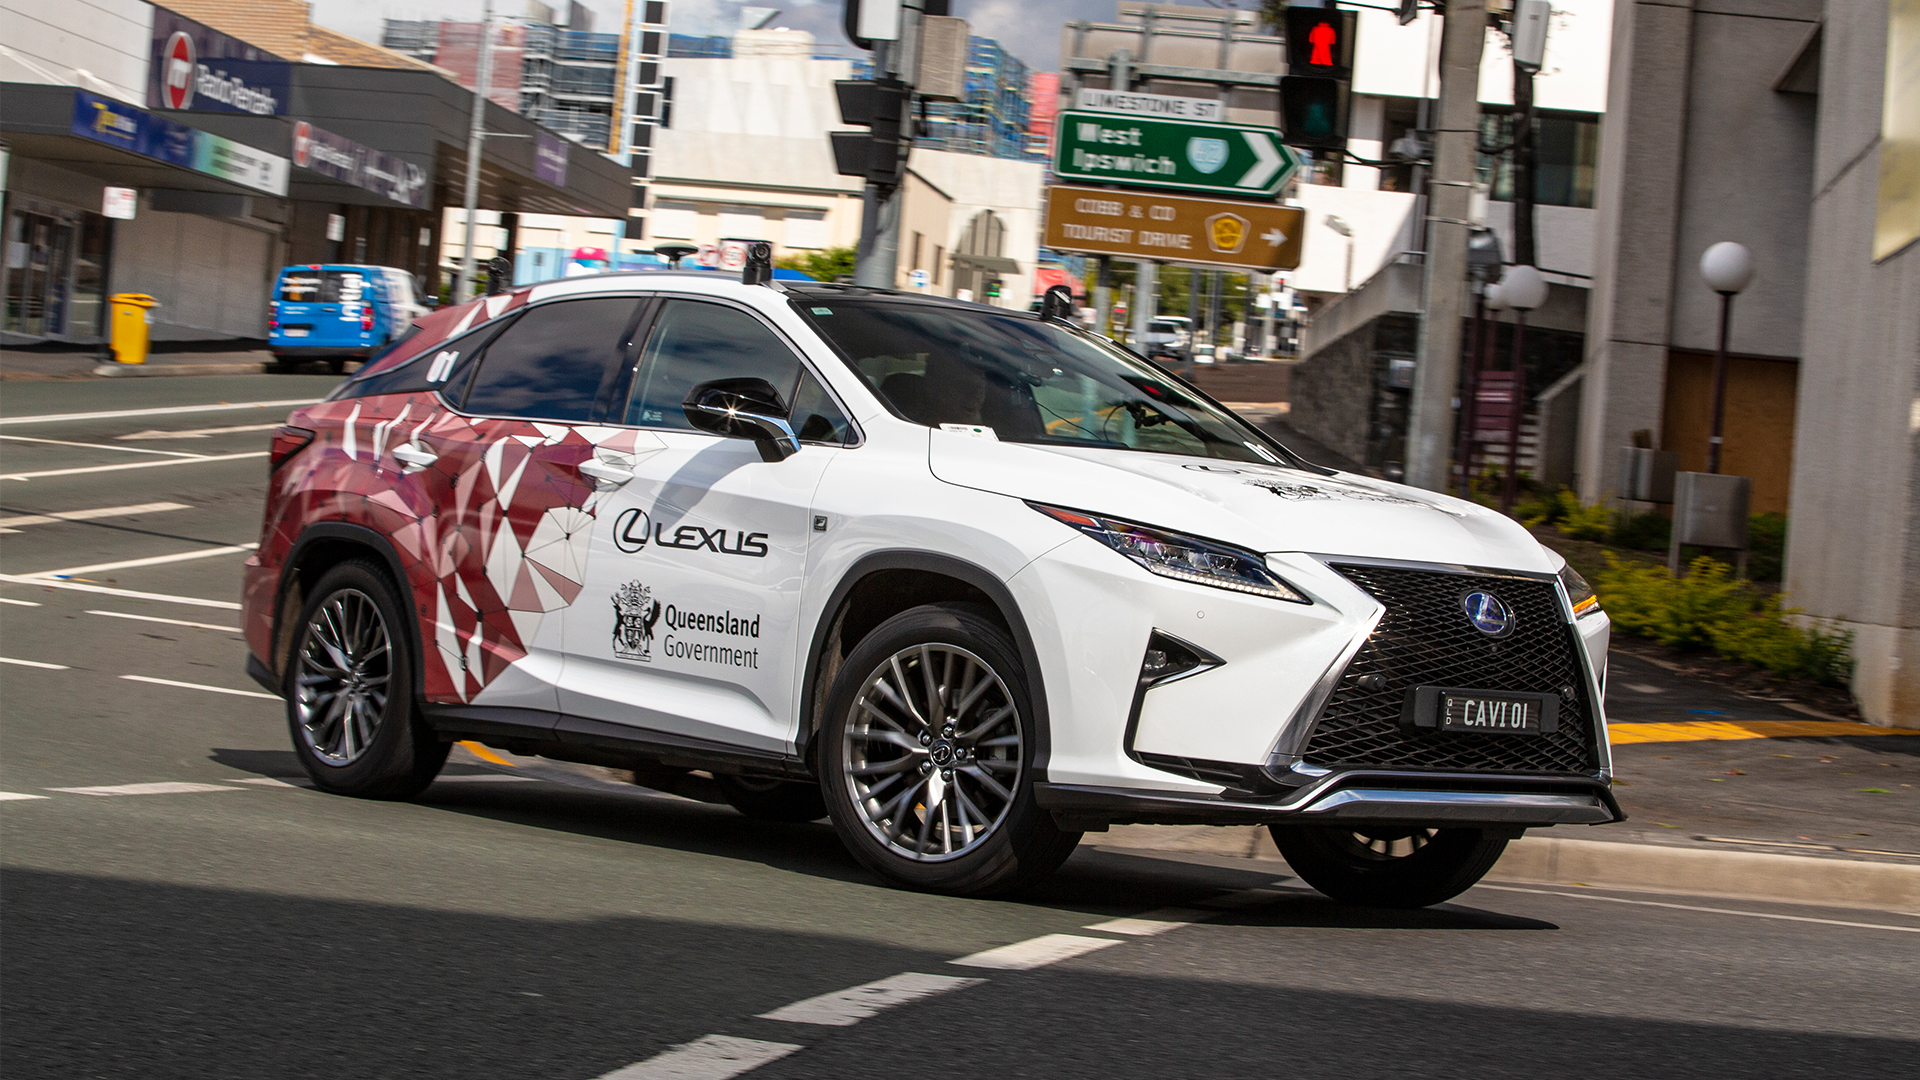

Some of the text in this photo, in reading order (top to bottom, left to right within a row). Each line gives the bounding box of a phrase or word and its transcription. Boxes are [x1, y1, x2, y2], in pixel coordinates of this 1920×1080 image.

[1083, 93, 1219, 117] LIMESTONE ST
[1076, 122, 1143, 146] West
[1073, 148, 1177, 176] Ipswich
[1074, 198, 1177, 222] COBB & CO
[1062, 223, 1194, 250] TOURIST DRIVE
[426, 350, 460, 383] 01
[655, 522, 769, 558] LEXUS
[665, 604, 761, 639] Queensland
[664, 634, 759, 669] Government
[1464, 700, 1507, 727] CAVI
